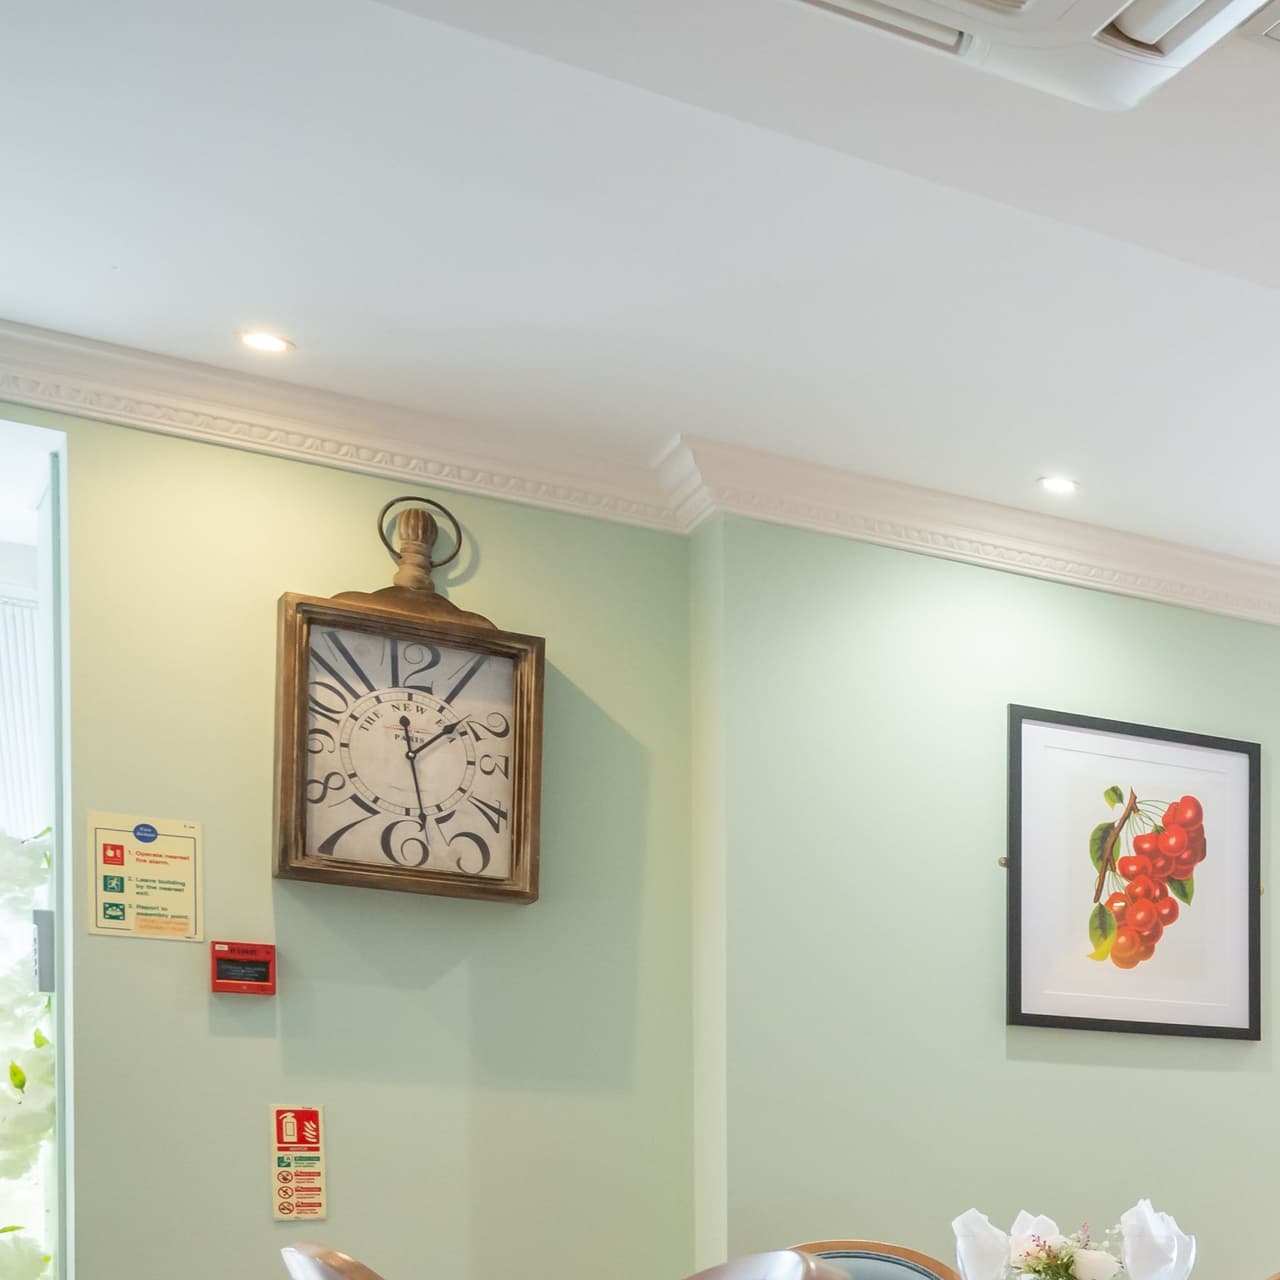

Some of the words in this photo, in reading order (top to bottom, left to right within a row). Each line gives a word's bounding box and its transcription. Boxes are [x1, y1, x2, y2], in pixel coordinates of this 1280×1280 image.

[310, 631, 378, 700] 11
[380, 637, 441, 695] 12
[447, 653, 490, 704] 1
[308, 727, 336, 754] 9
[359, 711, 383, 732] THE
[391, 703, 427, 715] NEW
[435, 718, 457, 745] EA
[394, 733, 425, 744] PARIS
[465, 712, 510, 742] 2
[307, 771, 346, 804] 8
[479, 753, 509, 780] 3
[317, 793, 381, 856] 7
[467, 792, 508, 834] 4
[380, 819, 430, 868] 6
[434, 809, 491, 875] 5
